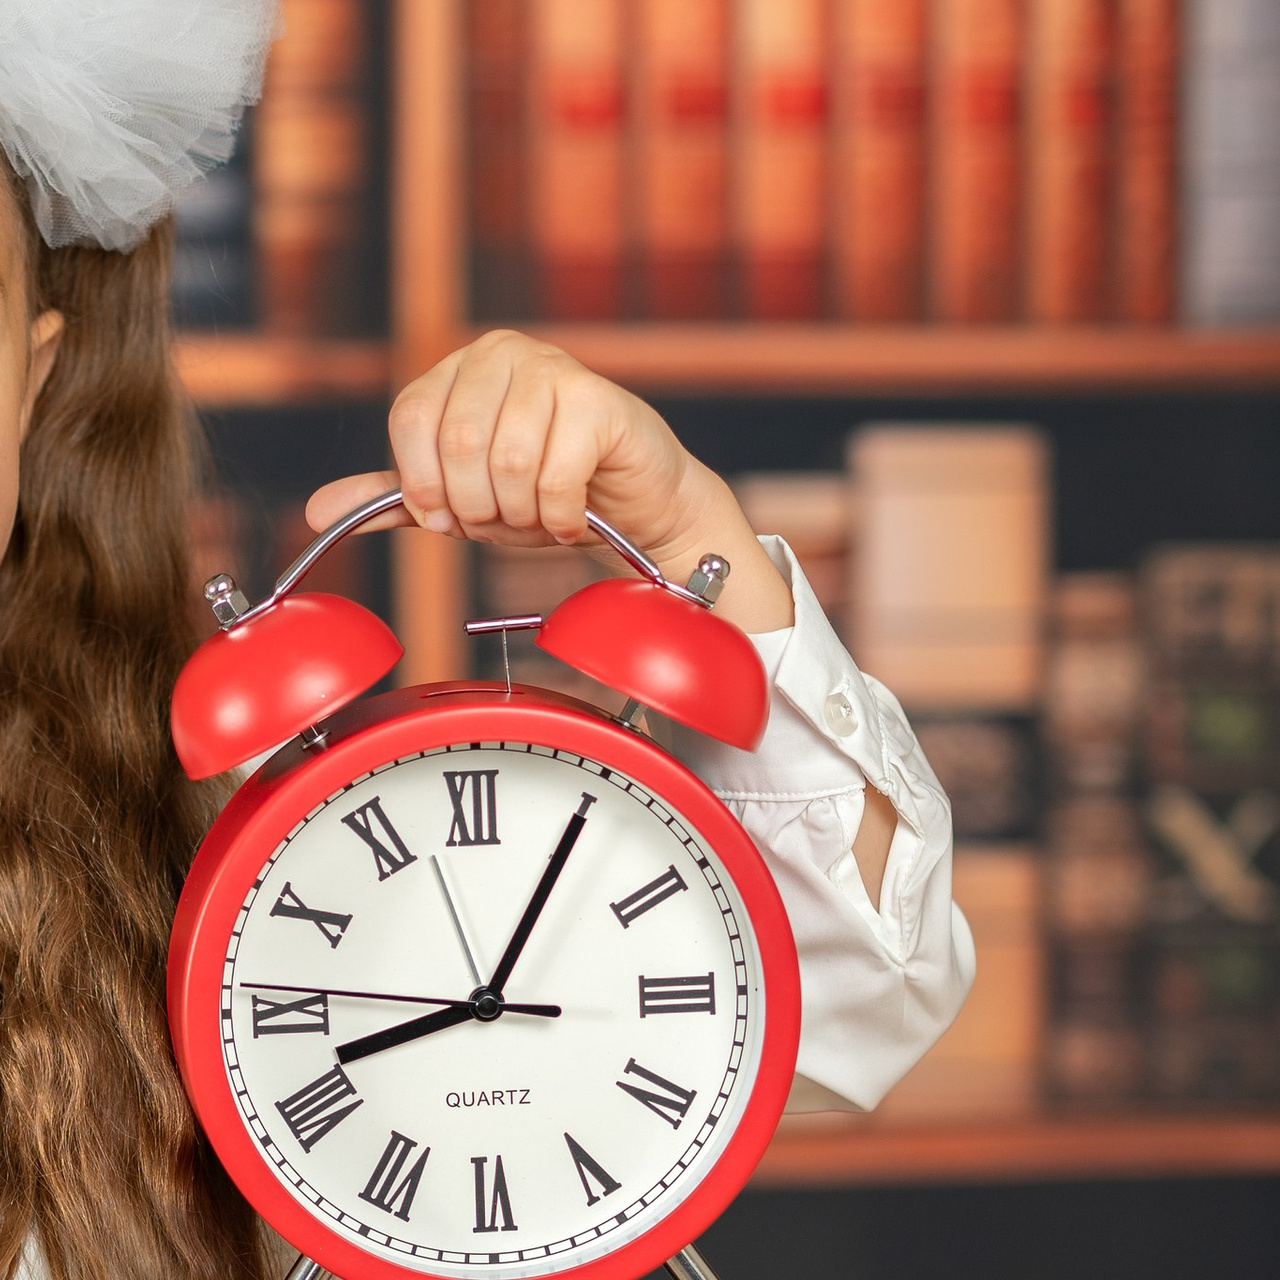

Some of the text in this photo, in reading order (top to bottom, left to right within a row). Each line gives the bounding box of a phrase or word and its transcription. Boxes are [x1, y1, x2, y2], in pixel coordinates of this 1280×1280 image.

[341, 795, 418, 882] XI
[443, 769, 501, 847] XII
[269, 881, 353, 949] X
[609, 864, 689, 929] II
[251, 993, 330, 1039] IX
[638, 971, 716, 1019] III
[274, 1062, 365, 1155] VIII
[445, 1089, 531, 1108] QUARTZ
[616, 1057, 697, 1130] IV
[358, 1129, 431, 1222] VII
[470, 1154, 518, 1233] VI
[563, 1132, 622, 1207] V
